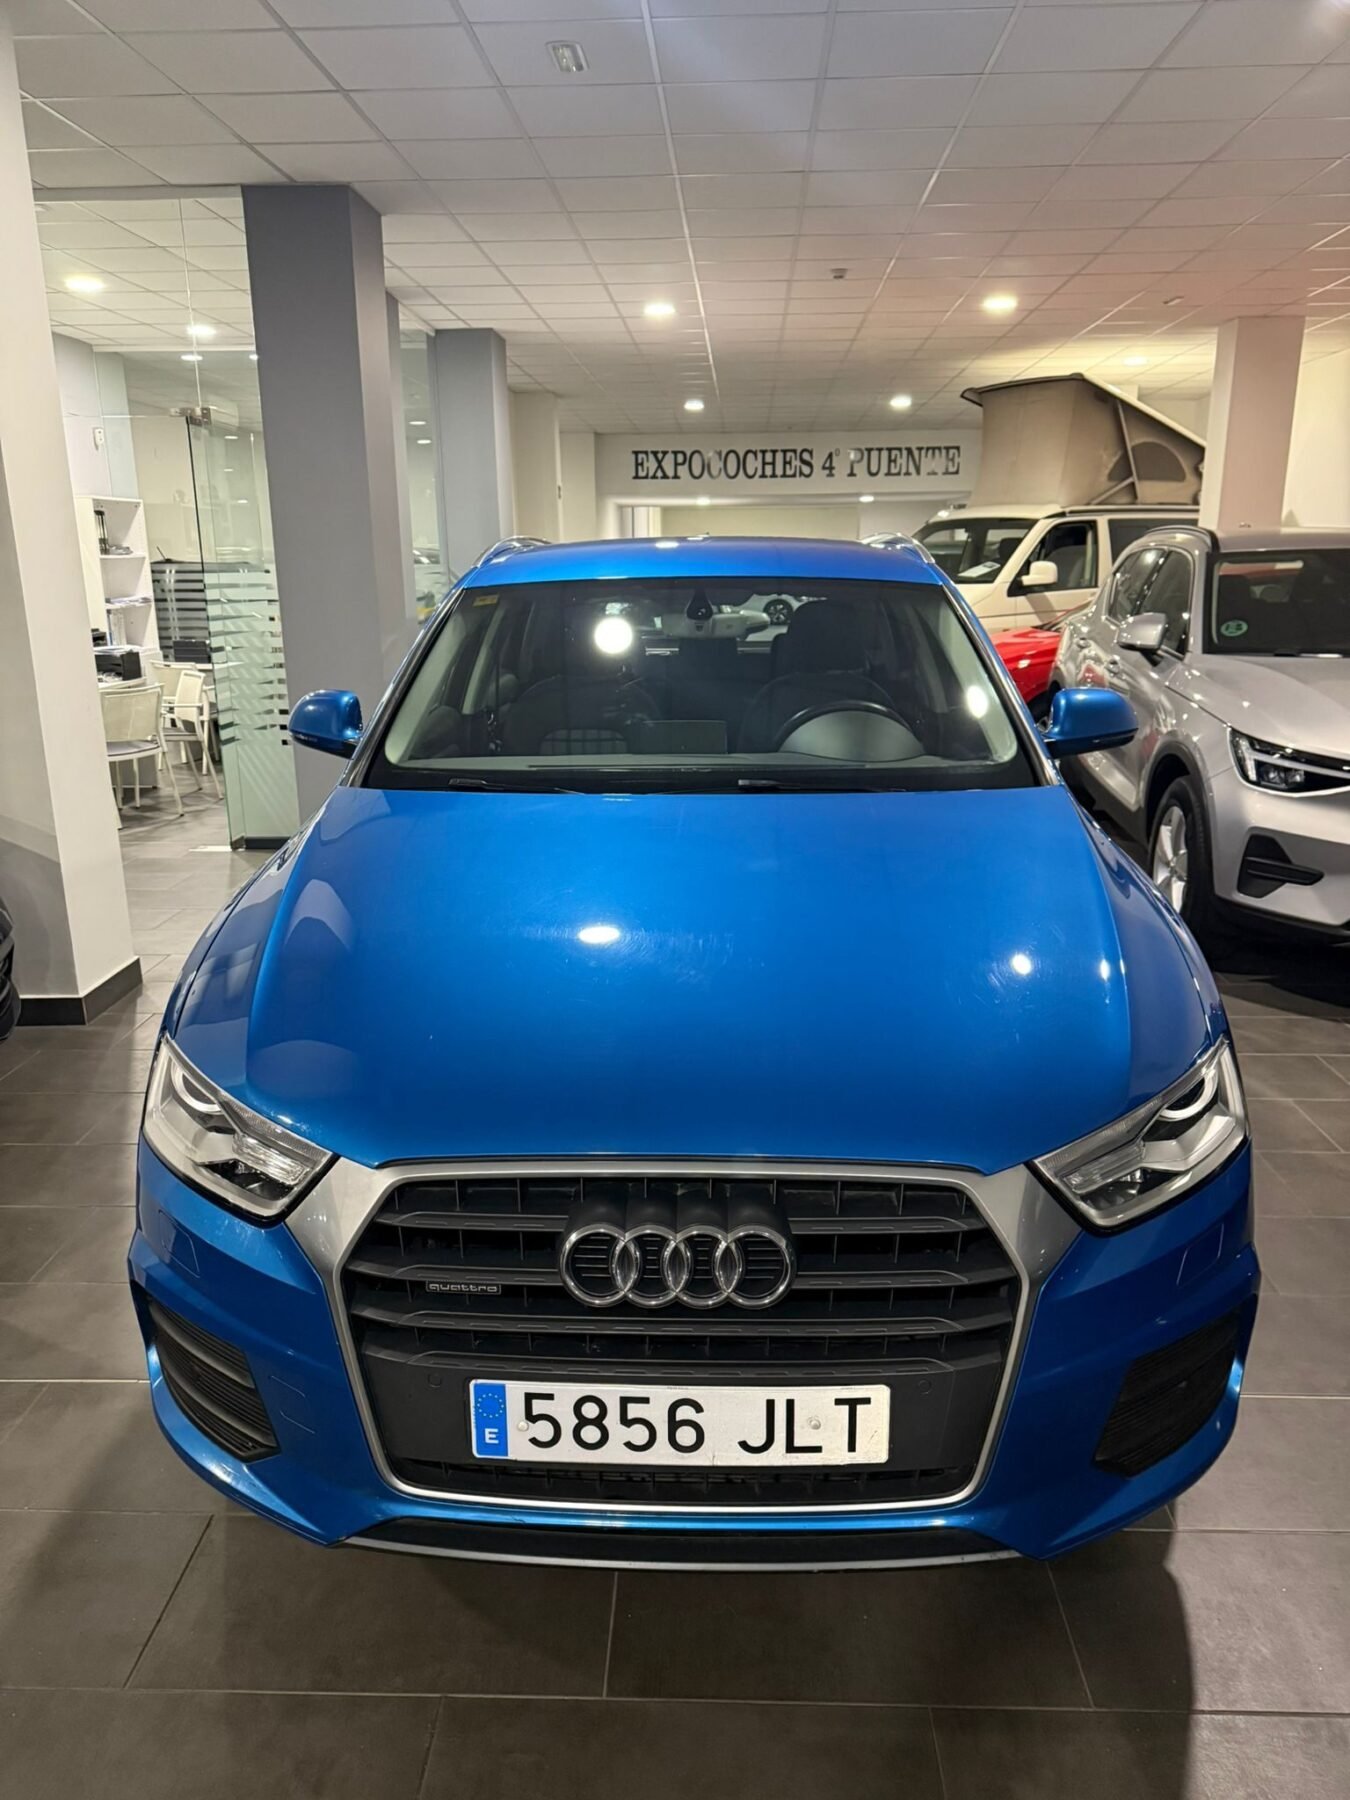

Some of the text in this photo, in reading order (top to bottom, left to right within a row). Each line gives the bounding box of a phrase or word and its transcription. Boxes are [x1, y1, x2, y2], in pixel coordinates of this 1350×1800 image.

[632, 448, 814, 480] EXPOCOCHES
[846, 446, 961, 477] PUENTE
[429, 1283, 498, 1293] quattro
[524, 1392, 705, 1454] 5856
[484, 1428, 500, 1444] E
